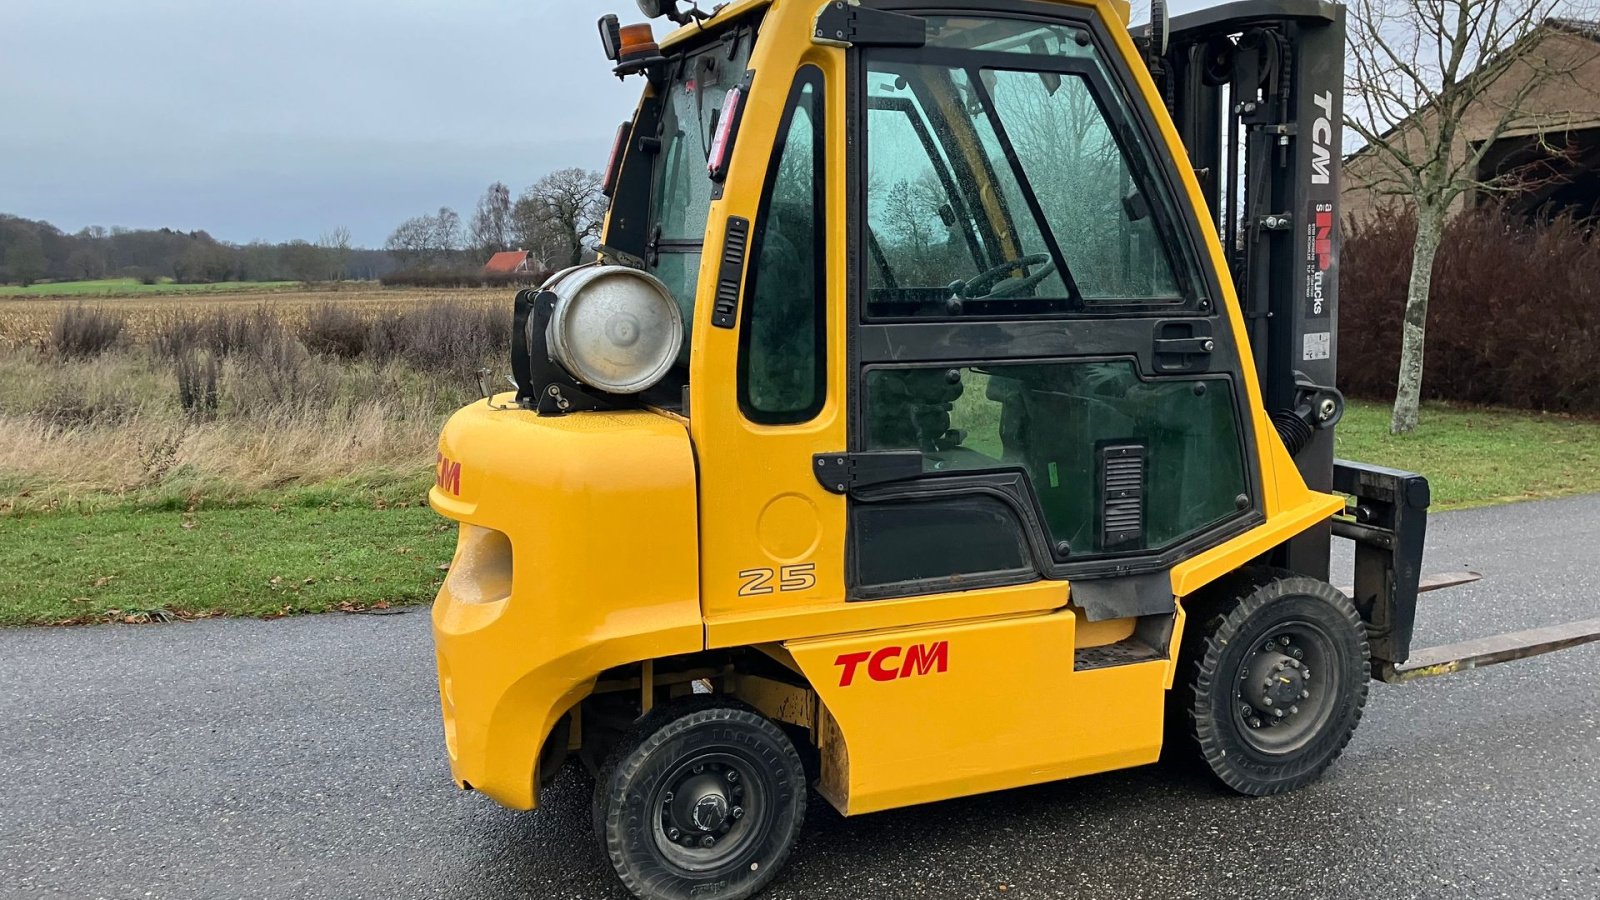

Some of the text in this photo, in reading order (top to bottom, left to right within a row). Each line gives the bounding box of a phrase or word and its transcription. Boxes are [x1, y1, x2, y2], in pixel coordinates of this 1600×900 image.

[1312, 90, 1333, 184] TCM
[1314, 270, 1325, 315] trucks
[738, 563, 816, 596] 25
[834, 641, 948, 687] TCM
